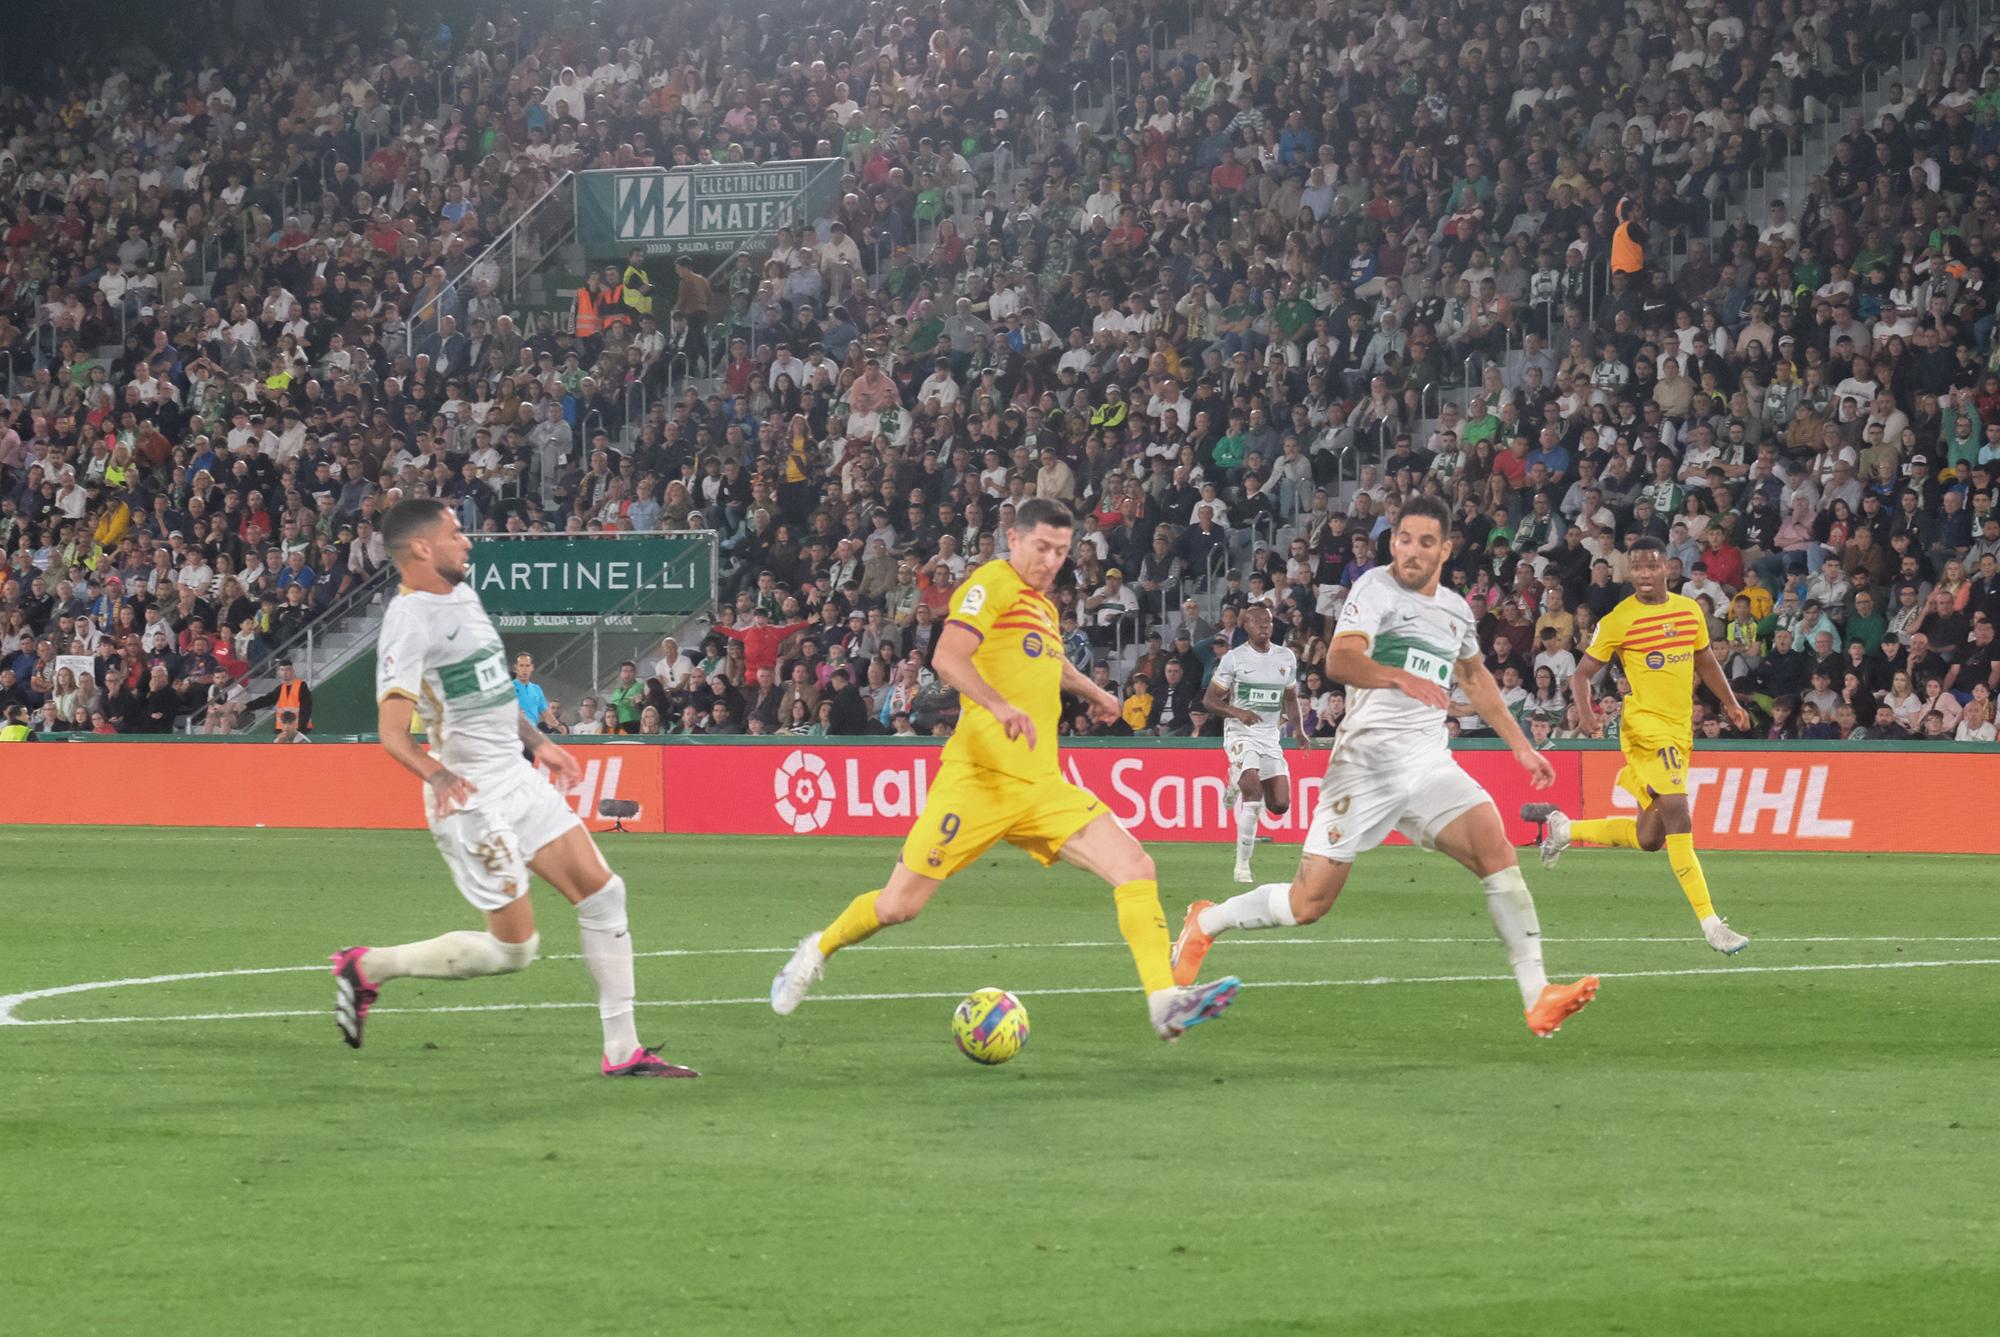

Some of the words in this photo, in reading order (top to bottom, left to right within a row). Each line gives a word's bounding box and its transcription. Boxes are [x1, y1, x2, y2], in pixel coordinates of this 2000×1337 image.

[701, 174, 794, 193] ELECTRICIDAD
[677, 242, 709, 252] SALIDA
[715, 241, 734, 251] EXIT
[533, 616, 568, 627] SALIDA
[1411, 656, 1430, 672] TM
[1657, 746, 1682, 770] 10
[940, 812, 961, 845] 9
